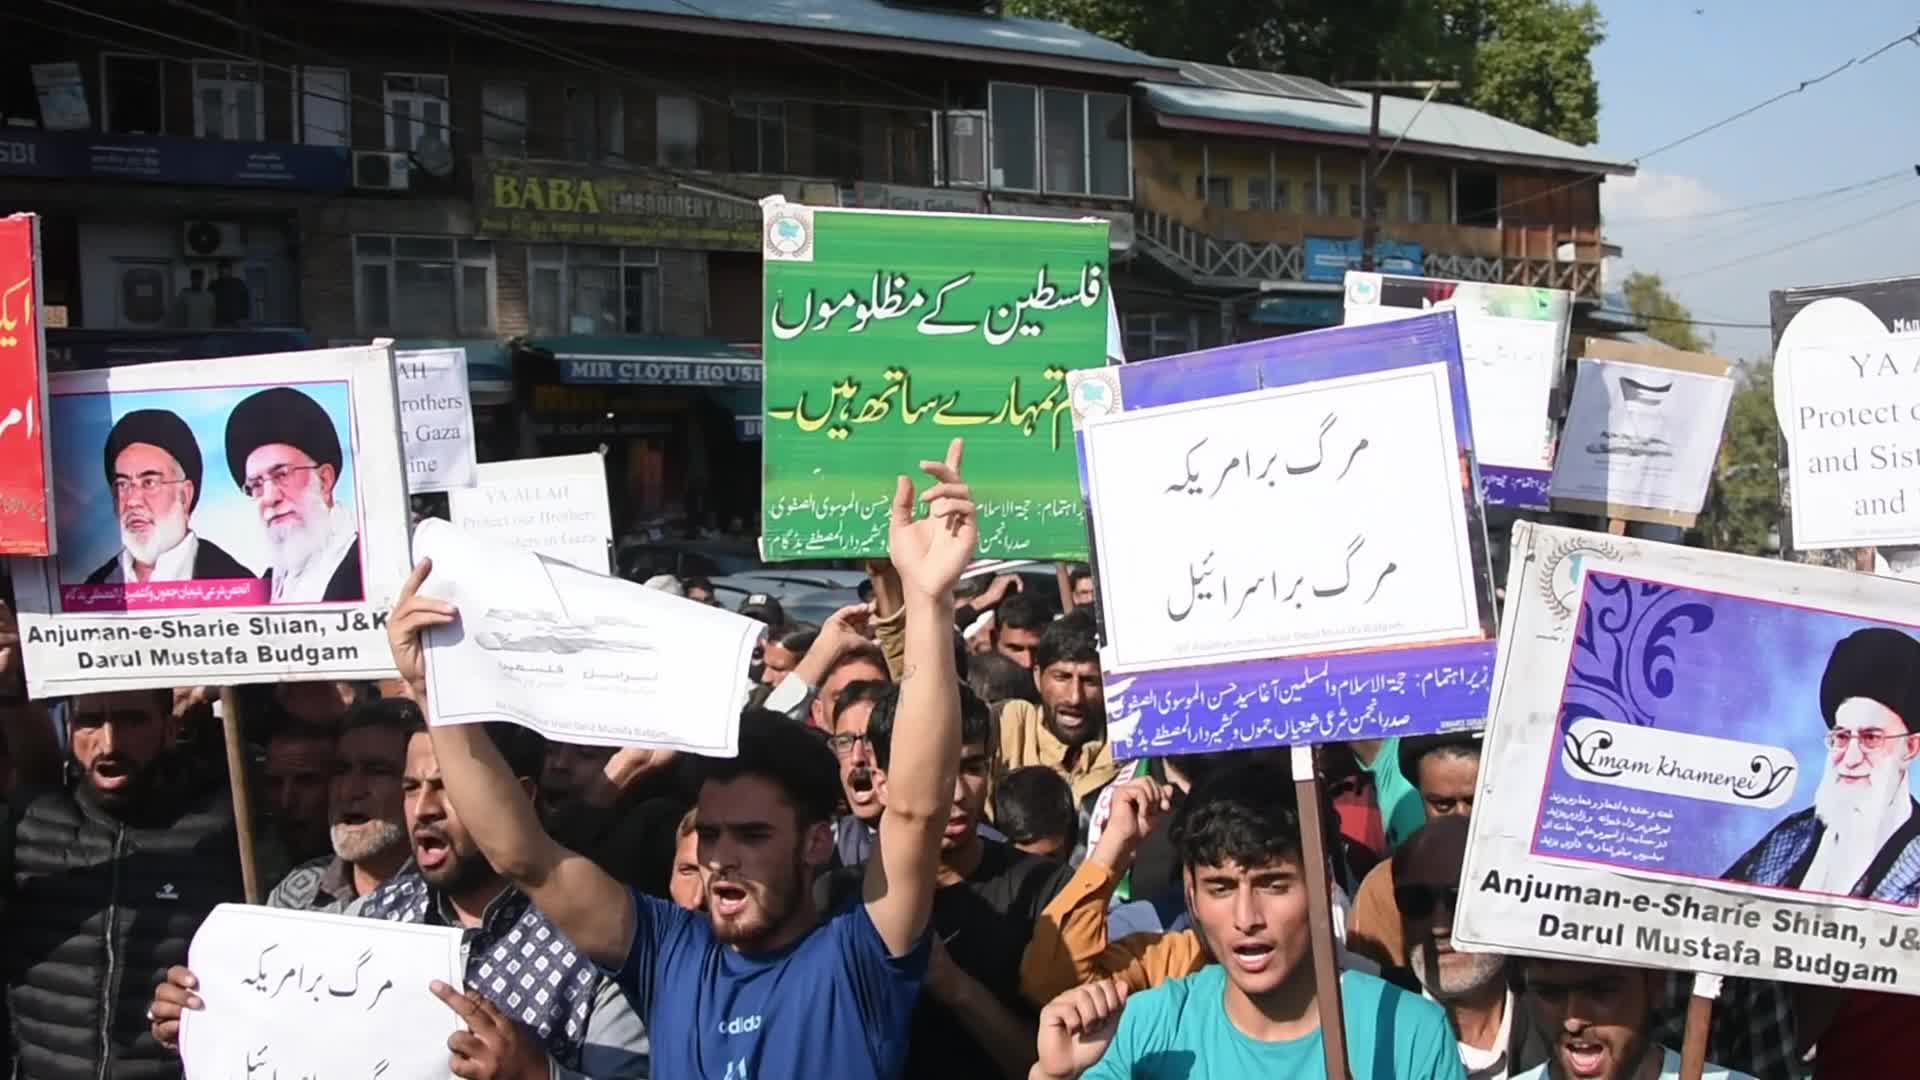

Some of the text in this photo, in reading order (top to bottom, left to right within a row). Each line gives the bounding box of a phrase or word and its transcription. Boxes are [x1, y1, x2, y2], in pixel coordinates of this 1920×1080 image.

[494, 174, 601, 214] BABA
[772, 263, 1102, 345] فلسطین کے مظلوموں
[570, 361, 614, 378] MIR
[618, 362, 690, 381] CLOTH
[1850, 353, 1900, 379] YA
[402, 394, 464, 413] rothers
[853, 368, 940, 425] ساتھ
[932, 369, 1065, 436] تمہارے
[1800, 402, 1899, 430] Protect
[415, 424, 461, 443] Gaza
[1285, 411, 1369, 483] مرگ
[409, 458, 438, 473] ine
[1808, 447, 1859, 475] and
[1854, 488, 1906, 518] and
[1312, 533, 1398, 605] مرگ
[26, 614, 241, 649] Anjuman-e-Sharie
[77, 642, 359, 671] Darul Mustafa Budgam
[1206, 681, 1238, 712] حسن
[1468, 664, 1490, 697] زیر
[1655, 754, 1757, 792] khamenei
[1479, 868, 1761, 928] Anjuman-e-Sharie
[1771, 907, 1867, 945] Shian,
[1538, 912, 1898, 986] Darul Mustafa Budgam
[328, 948, 394, 1010] مرگ
